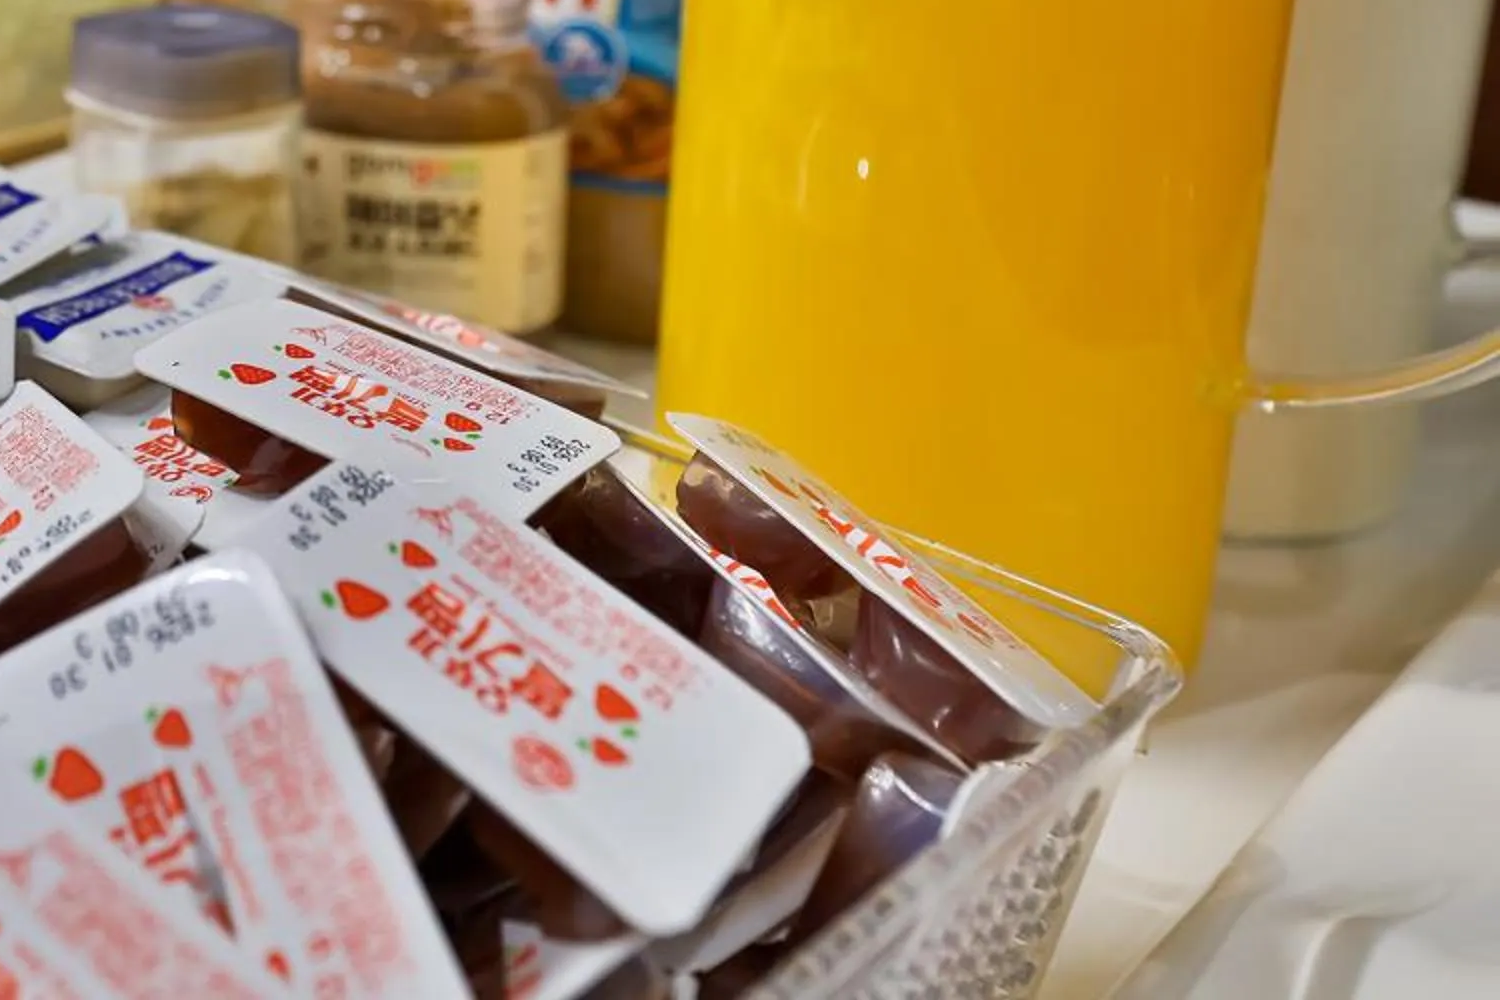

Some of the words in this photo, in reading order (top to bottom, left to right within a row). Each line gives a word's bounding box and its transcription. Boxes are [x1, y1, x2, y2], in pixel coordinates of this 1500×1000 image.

[286, 362, 430, 434] 딸기쨈
[287, 382, 378, 430] 오뚜기
[401, 575, 575, 722] 딸기쨈
[401, 626, 507, 718] 오뚜기
